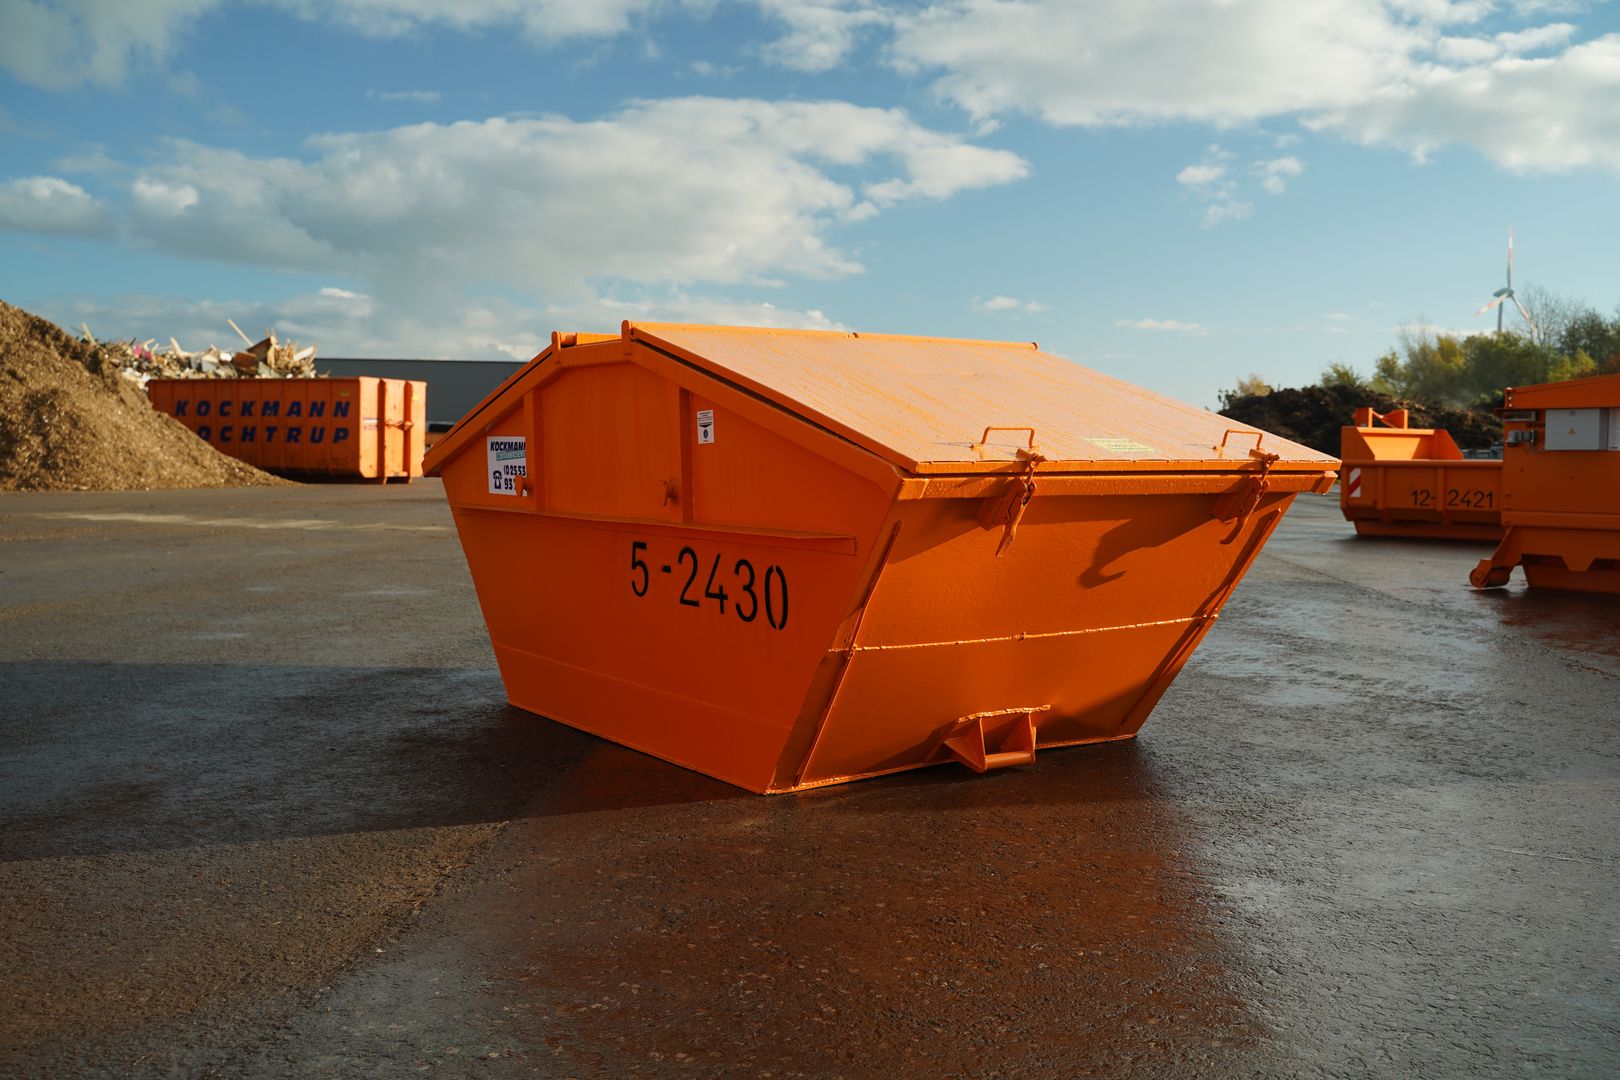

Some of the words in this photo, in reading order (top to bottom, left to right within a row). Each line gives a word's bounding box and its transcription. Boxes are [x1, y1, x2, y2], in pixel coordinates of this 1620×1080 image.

[175, 400, 350, 417] KOCKMANN
[196, 425, 349, 443] OCHTRUP
[631, 541, 789, 630] 5-2430
